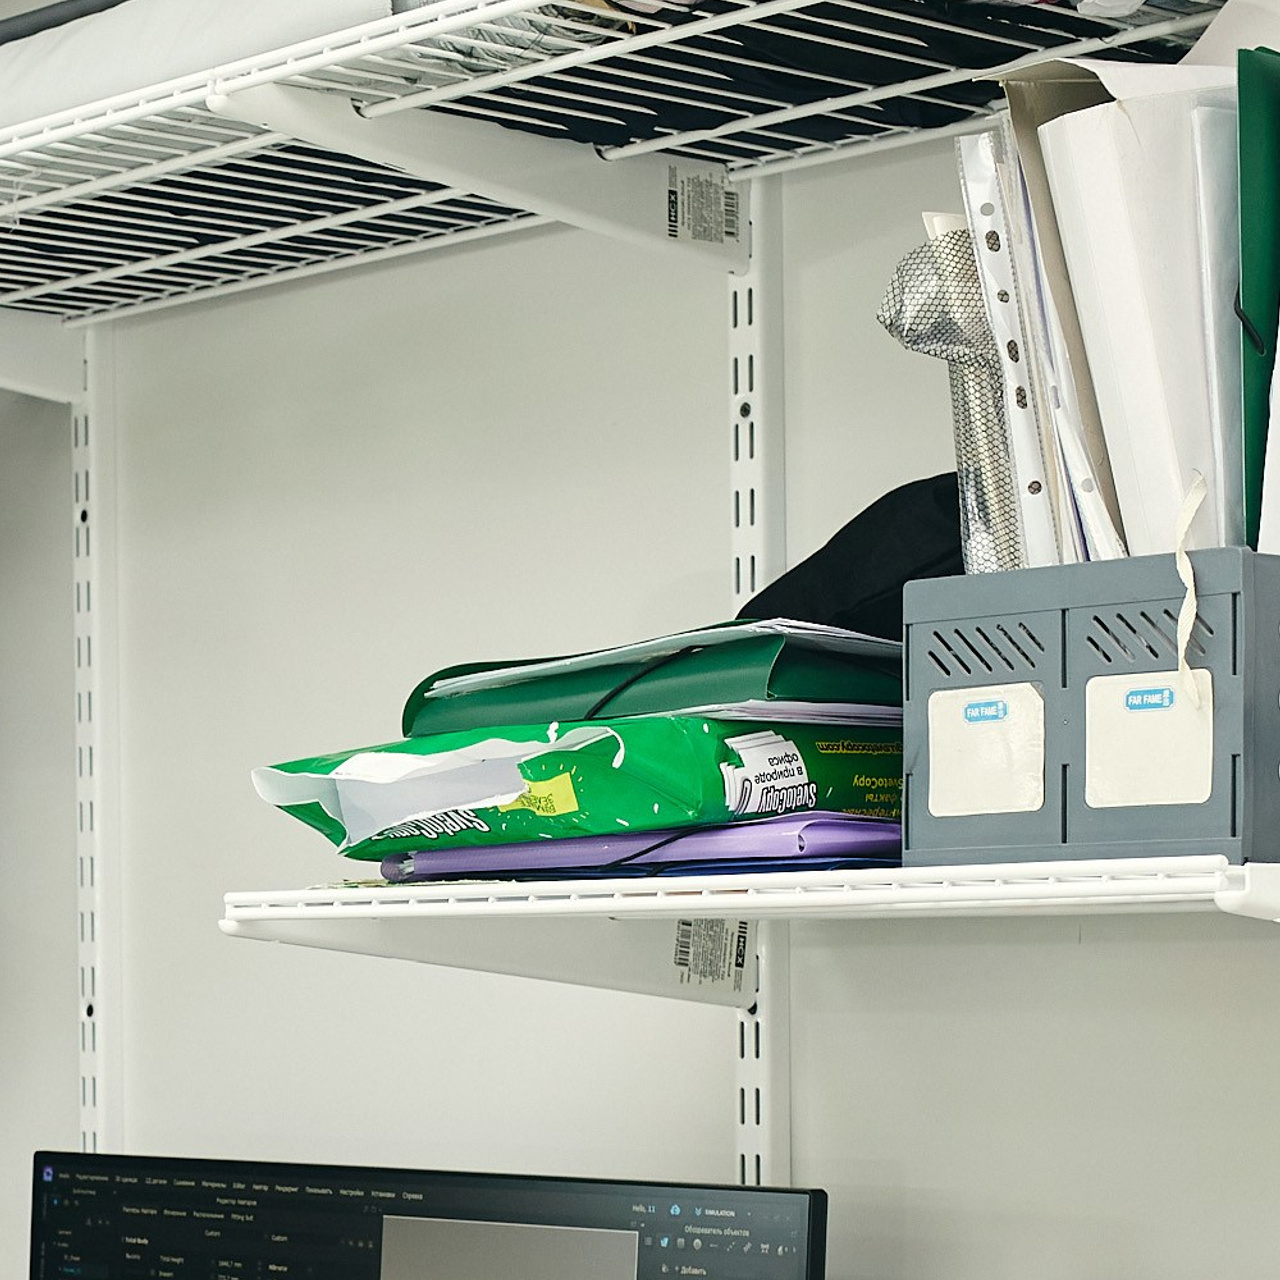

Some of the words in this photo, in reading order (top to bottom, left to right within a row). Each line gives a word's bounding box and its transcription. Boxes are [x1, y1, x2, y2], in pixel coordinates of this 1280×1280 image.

[1128, 695, 1142, 706] FAR
[1143, 693, 1162, 705] FAME
[768, 751, 799, 767] офиса
[754, 767, 795, 786] природе
[796, 766, 803, 776] в
[756, 782, 817, 814] SvetoCopy
